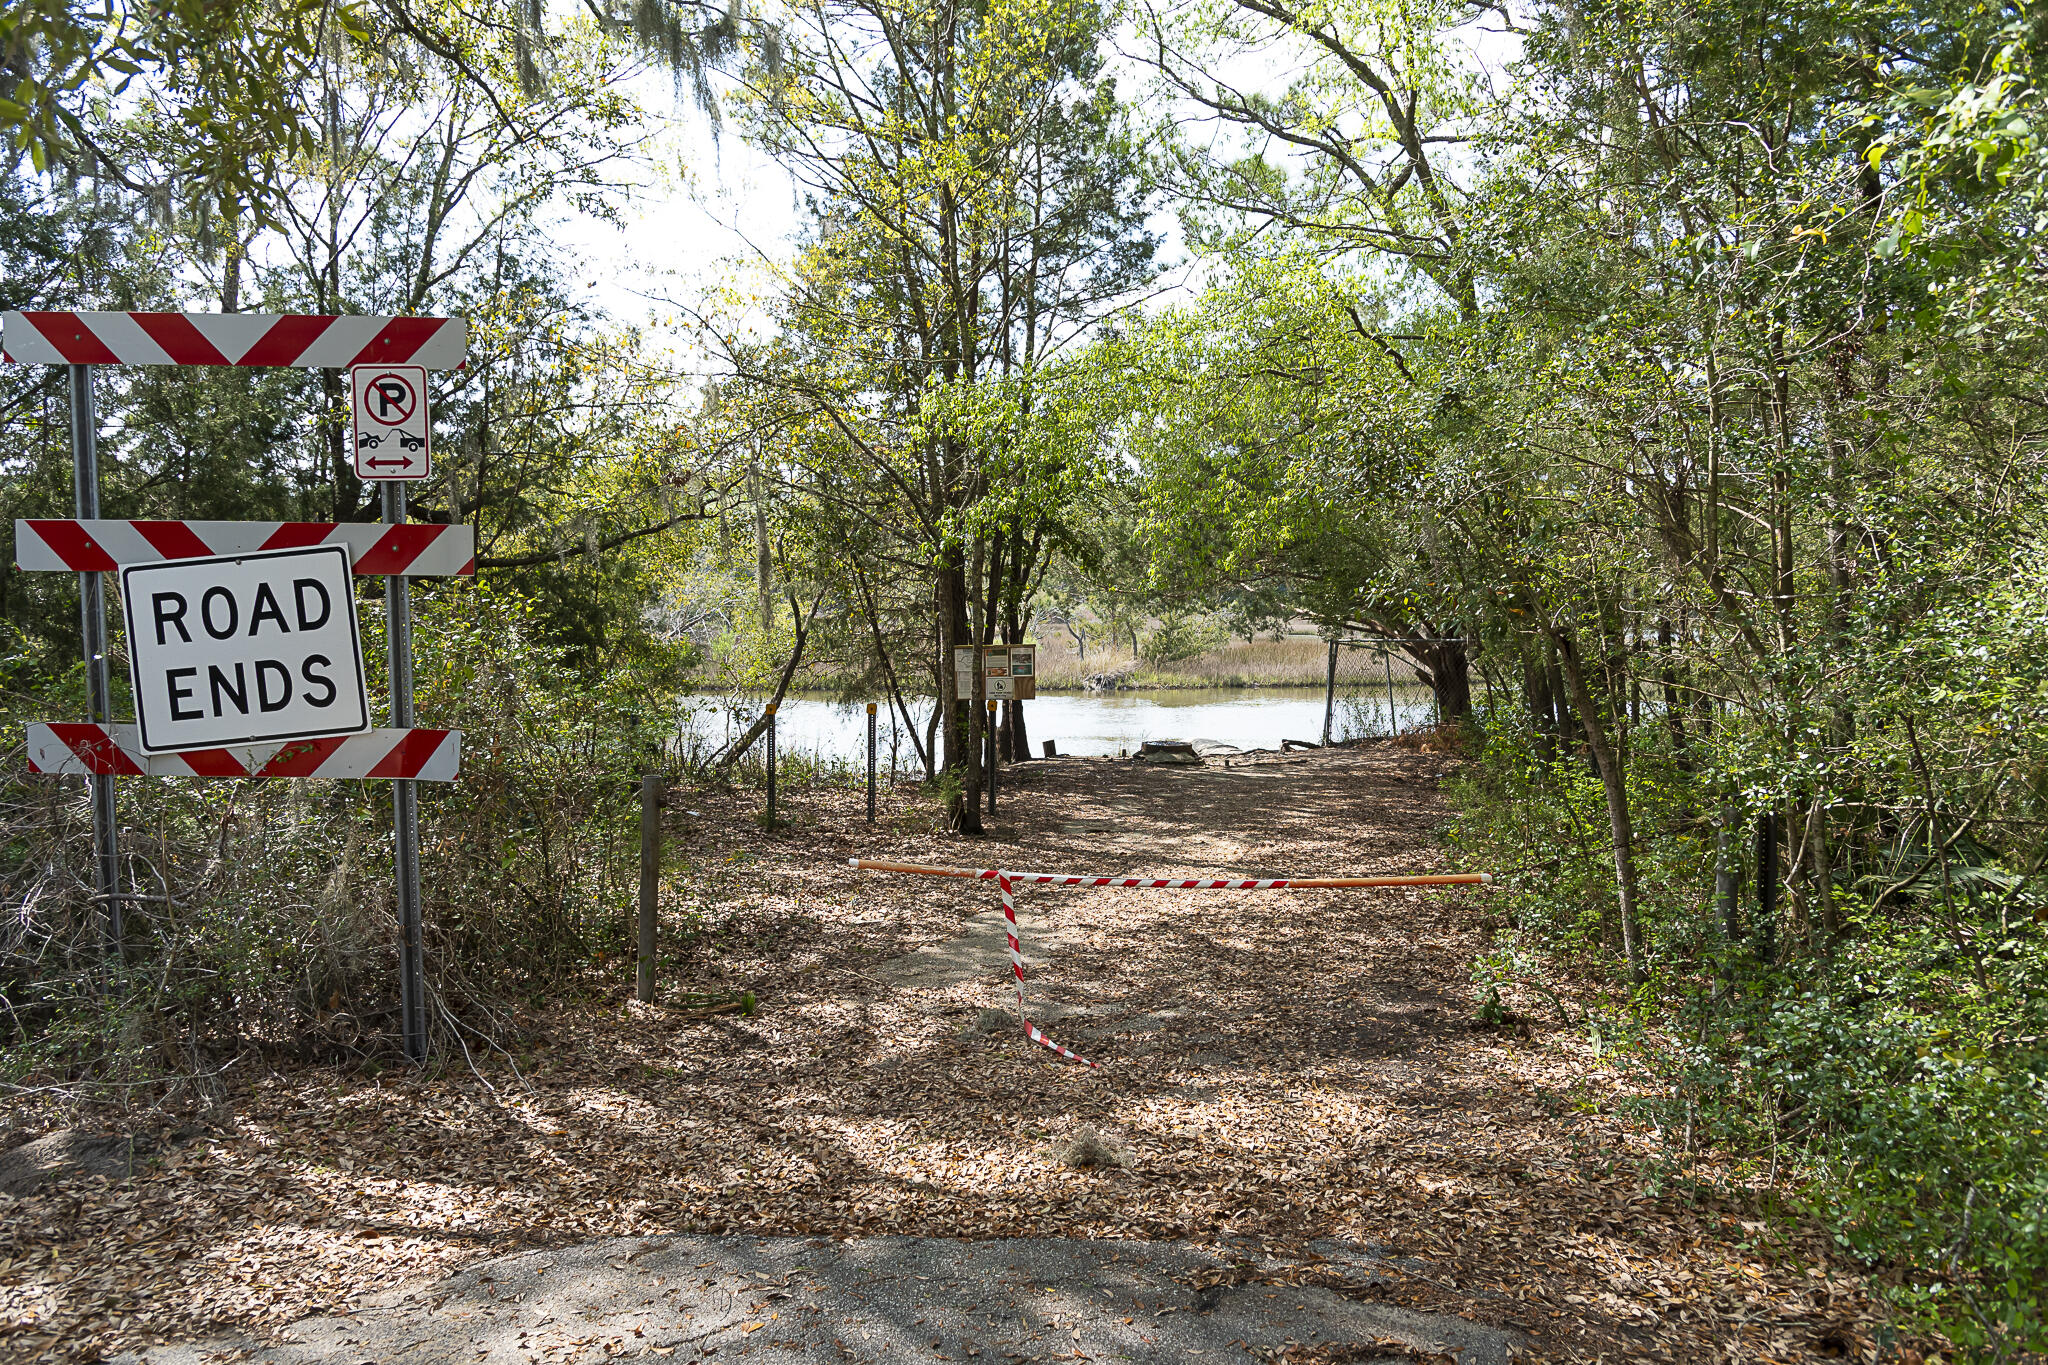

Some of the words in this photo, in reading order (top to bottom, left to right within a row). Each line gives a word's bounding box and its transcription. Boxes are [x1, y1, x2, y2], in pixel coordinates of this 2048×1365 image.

[379, 383, 406, 416] P
[152, 578, 331, 645] ROAD
[166, 654, 336, 721] ENDS
